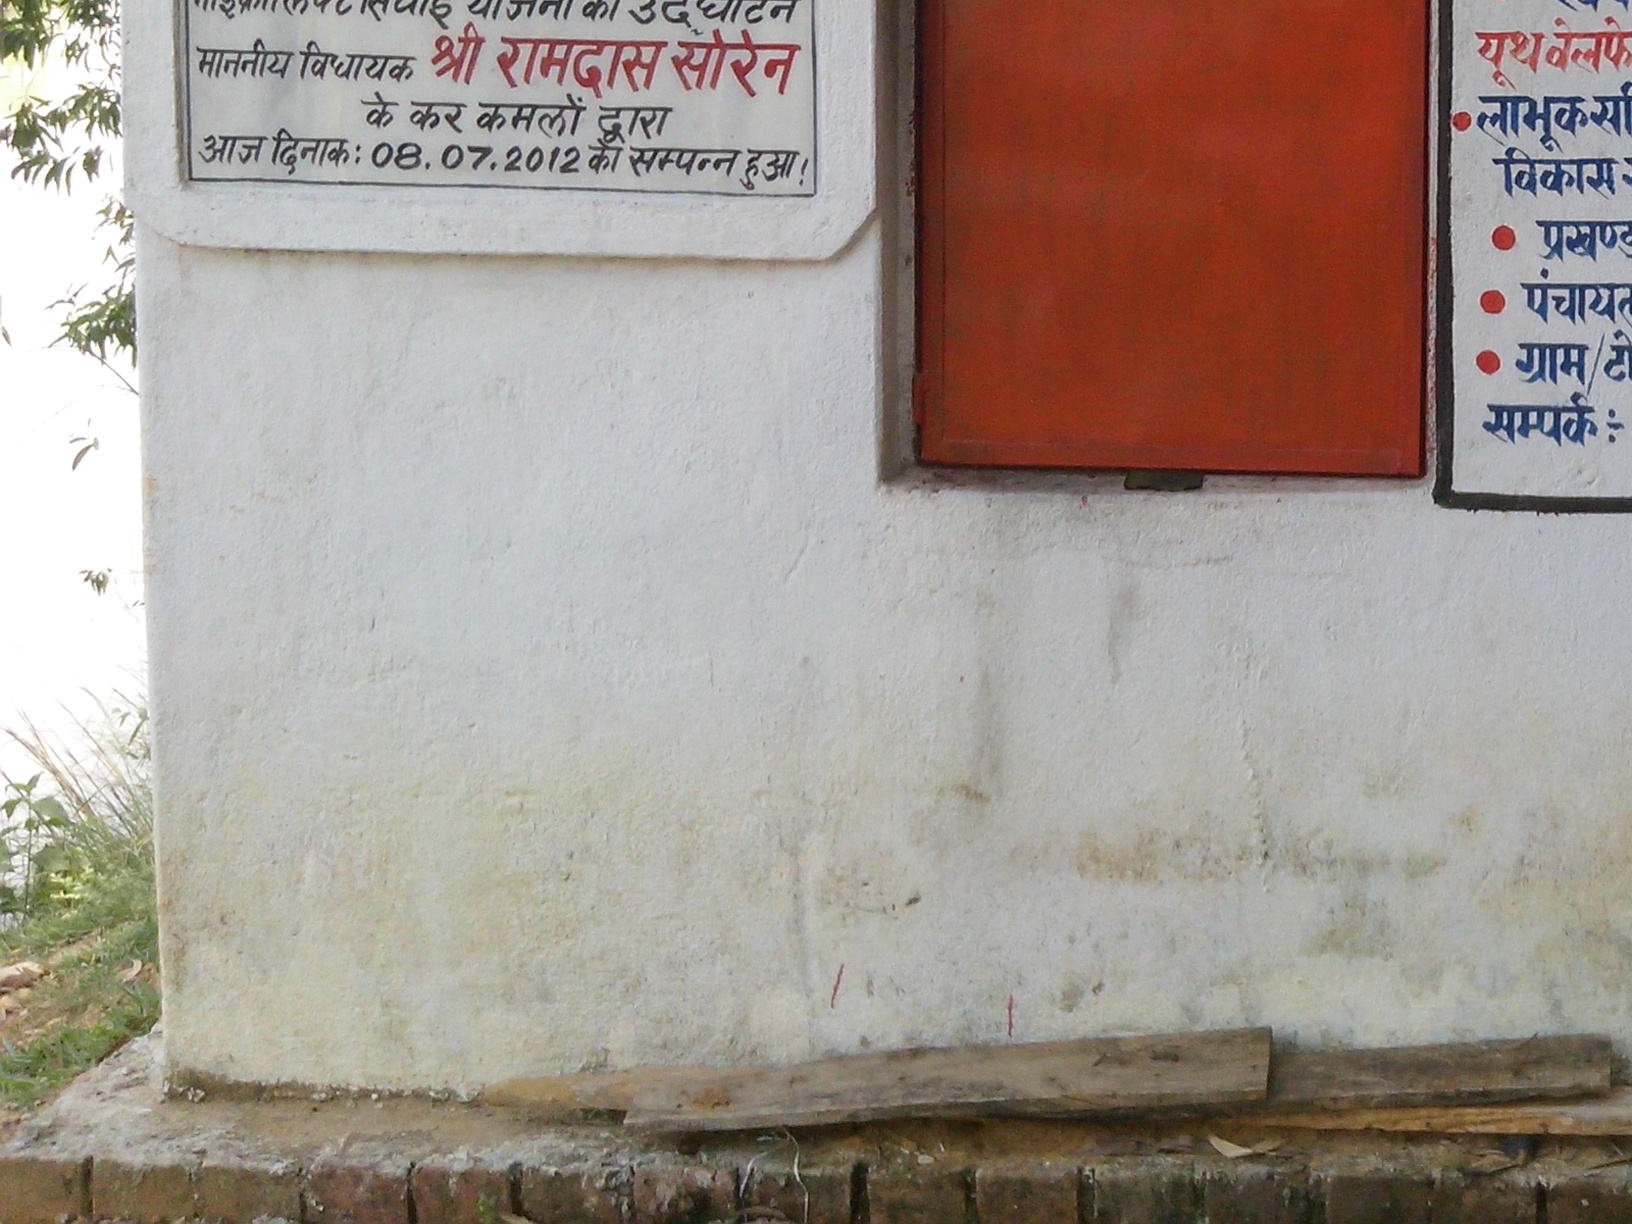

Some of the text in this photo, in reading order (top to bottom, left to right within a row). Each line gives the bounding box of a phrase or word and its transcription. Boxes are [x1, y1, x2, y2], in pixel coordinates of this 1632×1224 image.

[197, 20, 802, 98] माननीय विधायक श्री रामदास सोरेन
[360, 91, 673, 144] के कर कमलों द्वारा
[198, 135, 268, 165] आज
[587, 137, 623, 174] को
[628, 146, 742, 178] सम्पन्न
[1492, 147, 1619, 200] विकास
